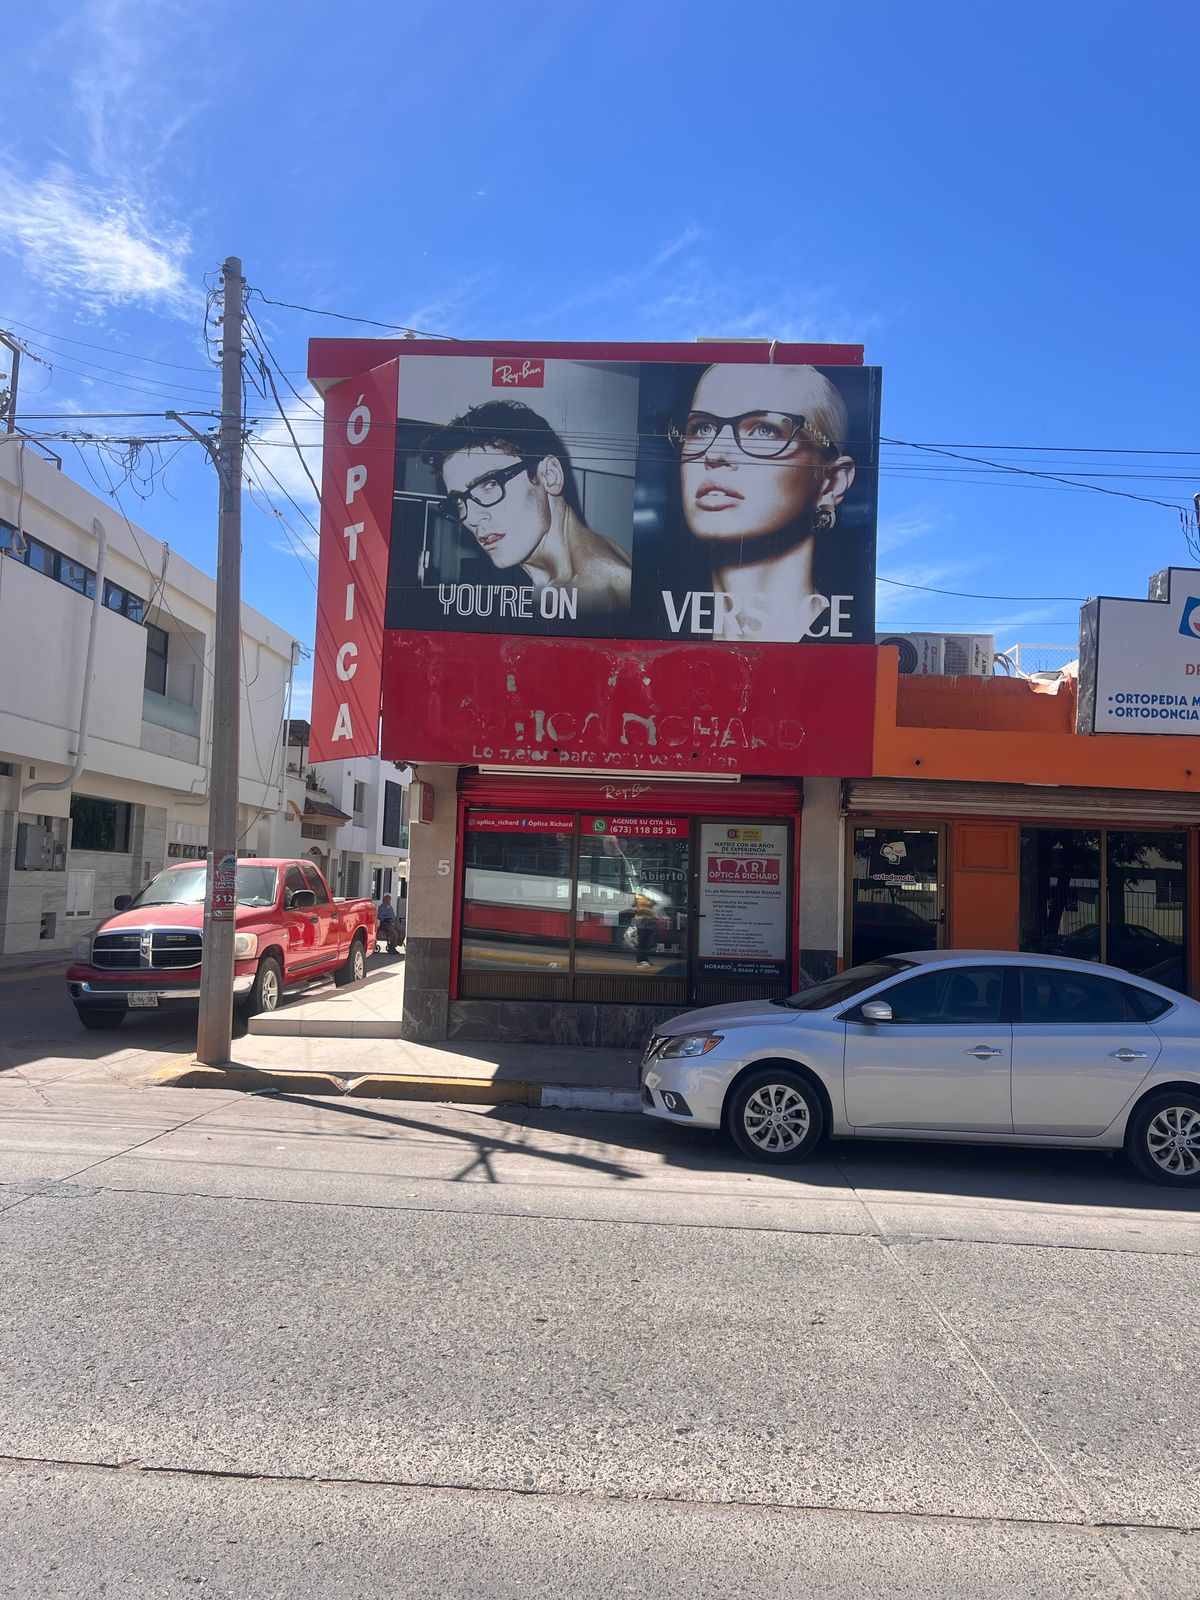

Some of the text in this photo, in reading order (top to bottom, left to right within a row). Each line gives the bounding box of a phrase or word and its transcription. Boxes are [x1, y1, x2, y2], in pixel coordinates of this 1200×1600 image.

[495, 360, 542, 385] Ray-Ban
[331, 393, 371, 742] ÓPTICA
[438, 583, 577, 620] YOU'RE ON
[661, 590, 854, 638] VERSCE
[1115, 693, 1188, 706] ORTOPEDIA
[1115, 706, 1199, 720] ORTODONCIA
[600, 783, 653, 801] Ray-Ban
[549, 820, 573, 828] Richard
[609, 825, 677, 835] (673) 118 85 30
[437, 859, 451, 876] 5
[751, 862, 759, 873] R
[641, 870, 684, 881] Abierto
[741, 872, 778, 880] RICHARD
